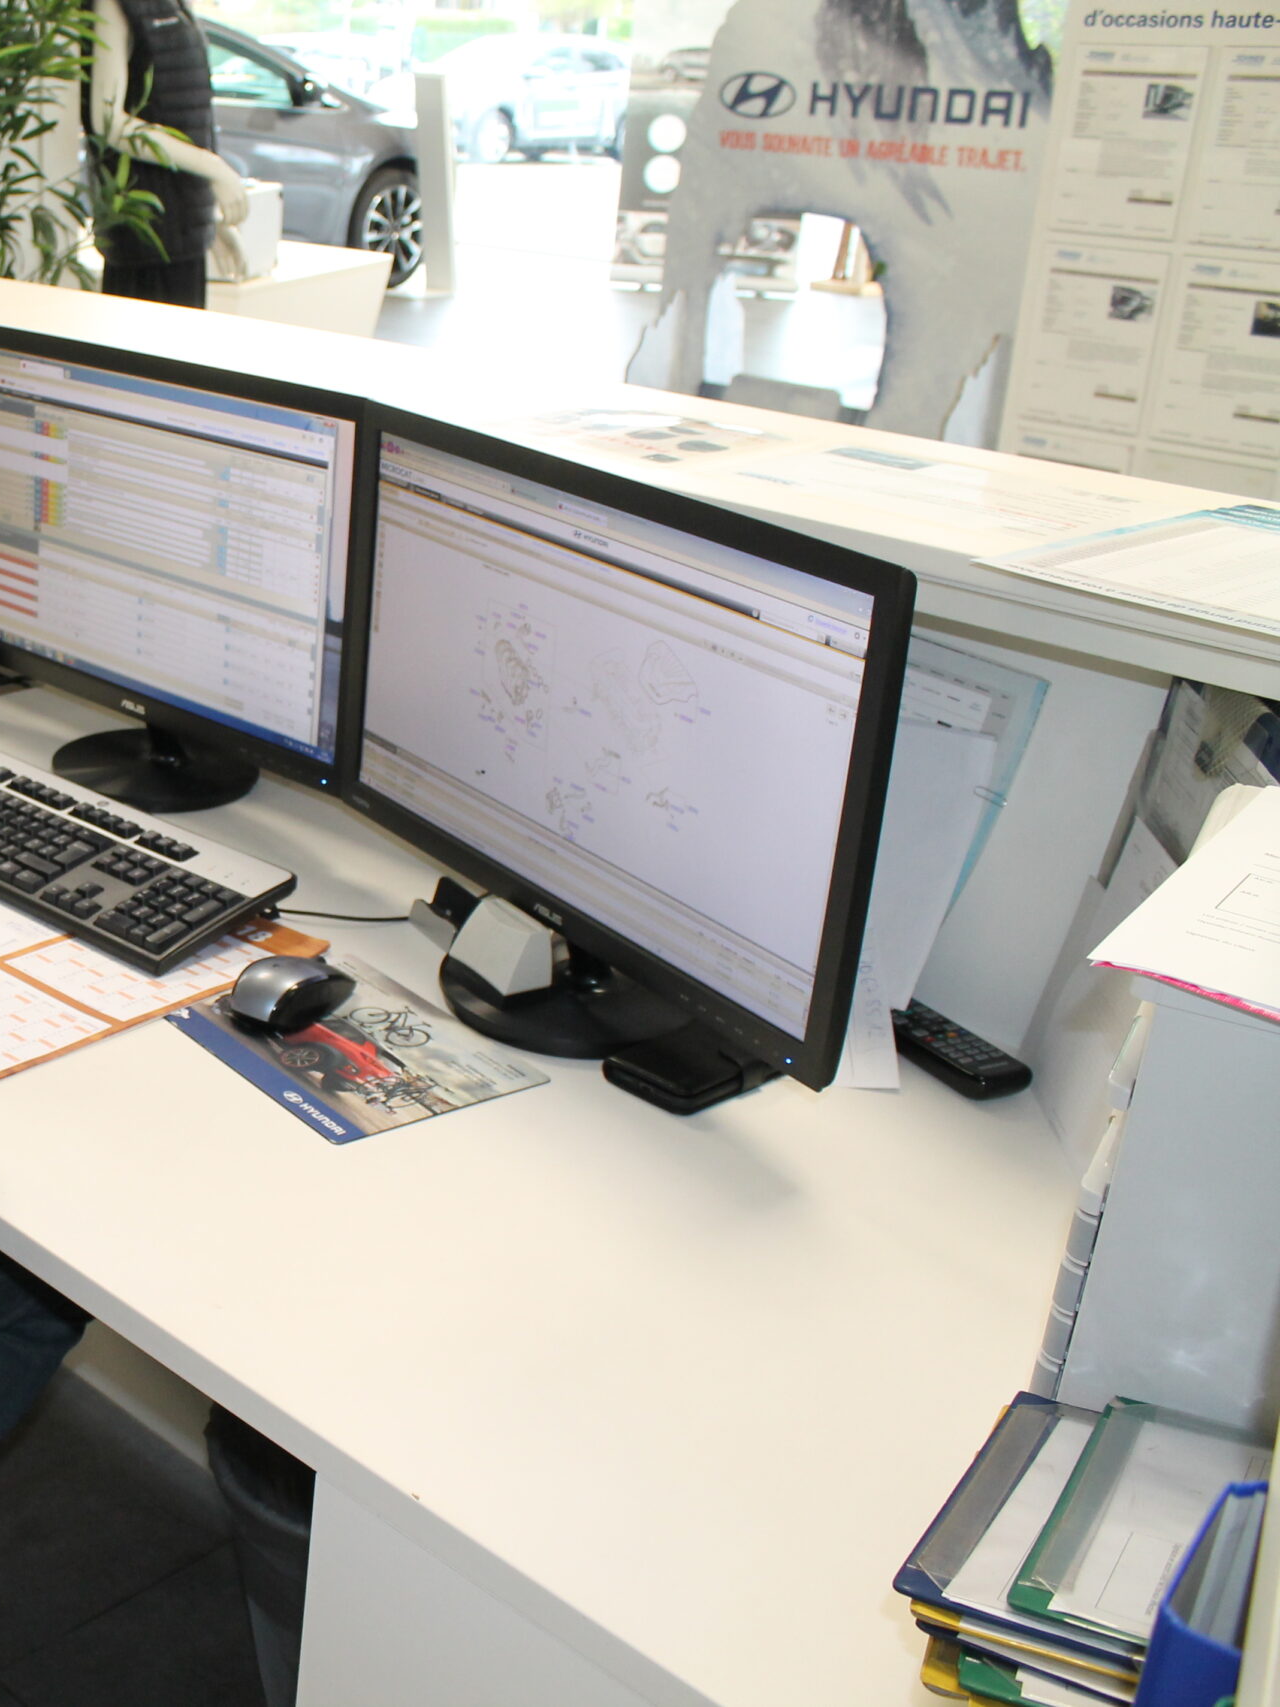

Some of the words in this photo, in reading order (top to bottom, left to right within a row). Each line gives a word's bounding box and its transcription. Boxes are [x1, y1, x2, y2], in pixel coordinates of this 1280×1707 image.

[1084, 10, 1204, 28] d'occasions
[809, 80, 1032, 129] HYUNDAI
[720, 129, 757, 150] VOUS
[761, 132, 832, 157] SOUHAITE
[840, 138, 860, 158] UN
[865, 135, 950, 167] AGRÉABLE
[957, 146, 1028, 171] TRAJET.
[299, 1102, 347, 1136] HYUNDAI
